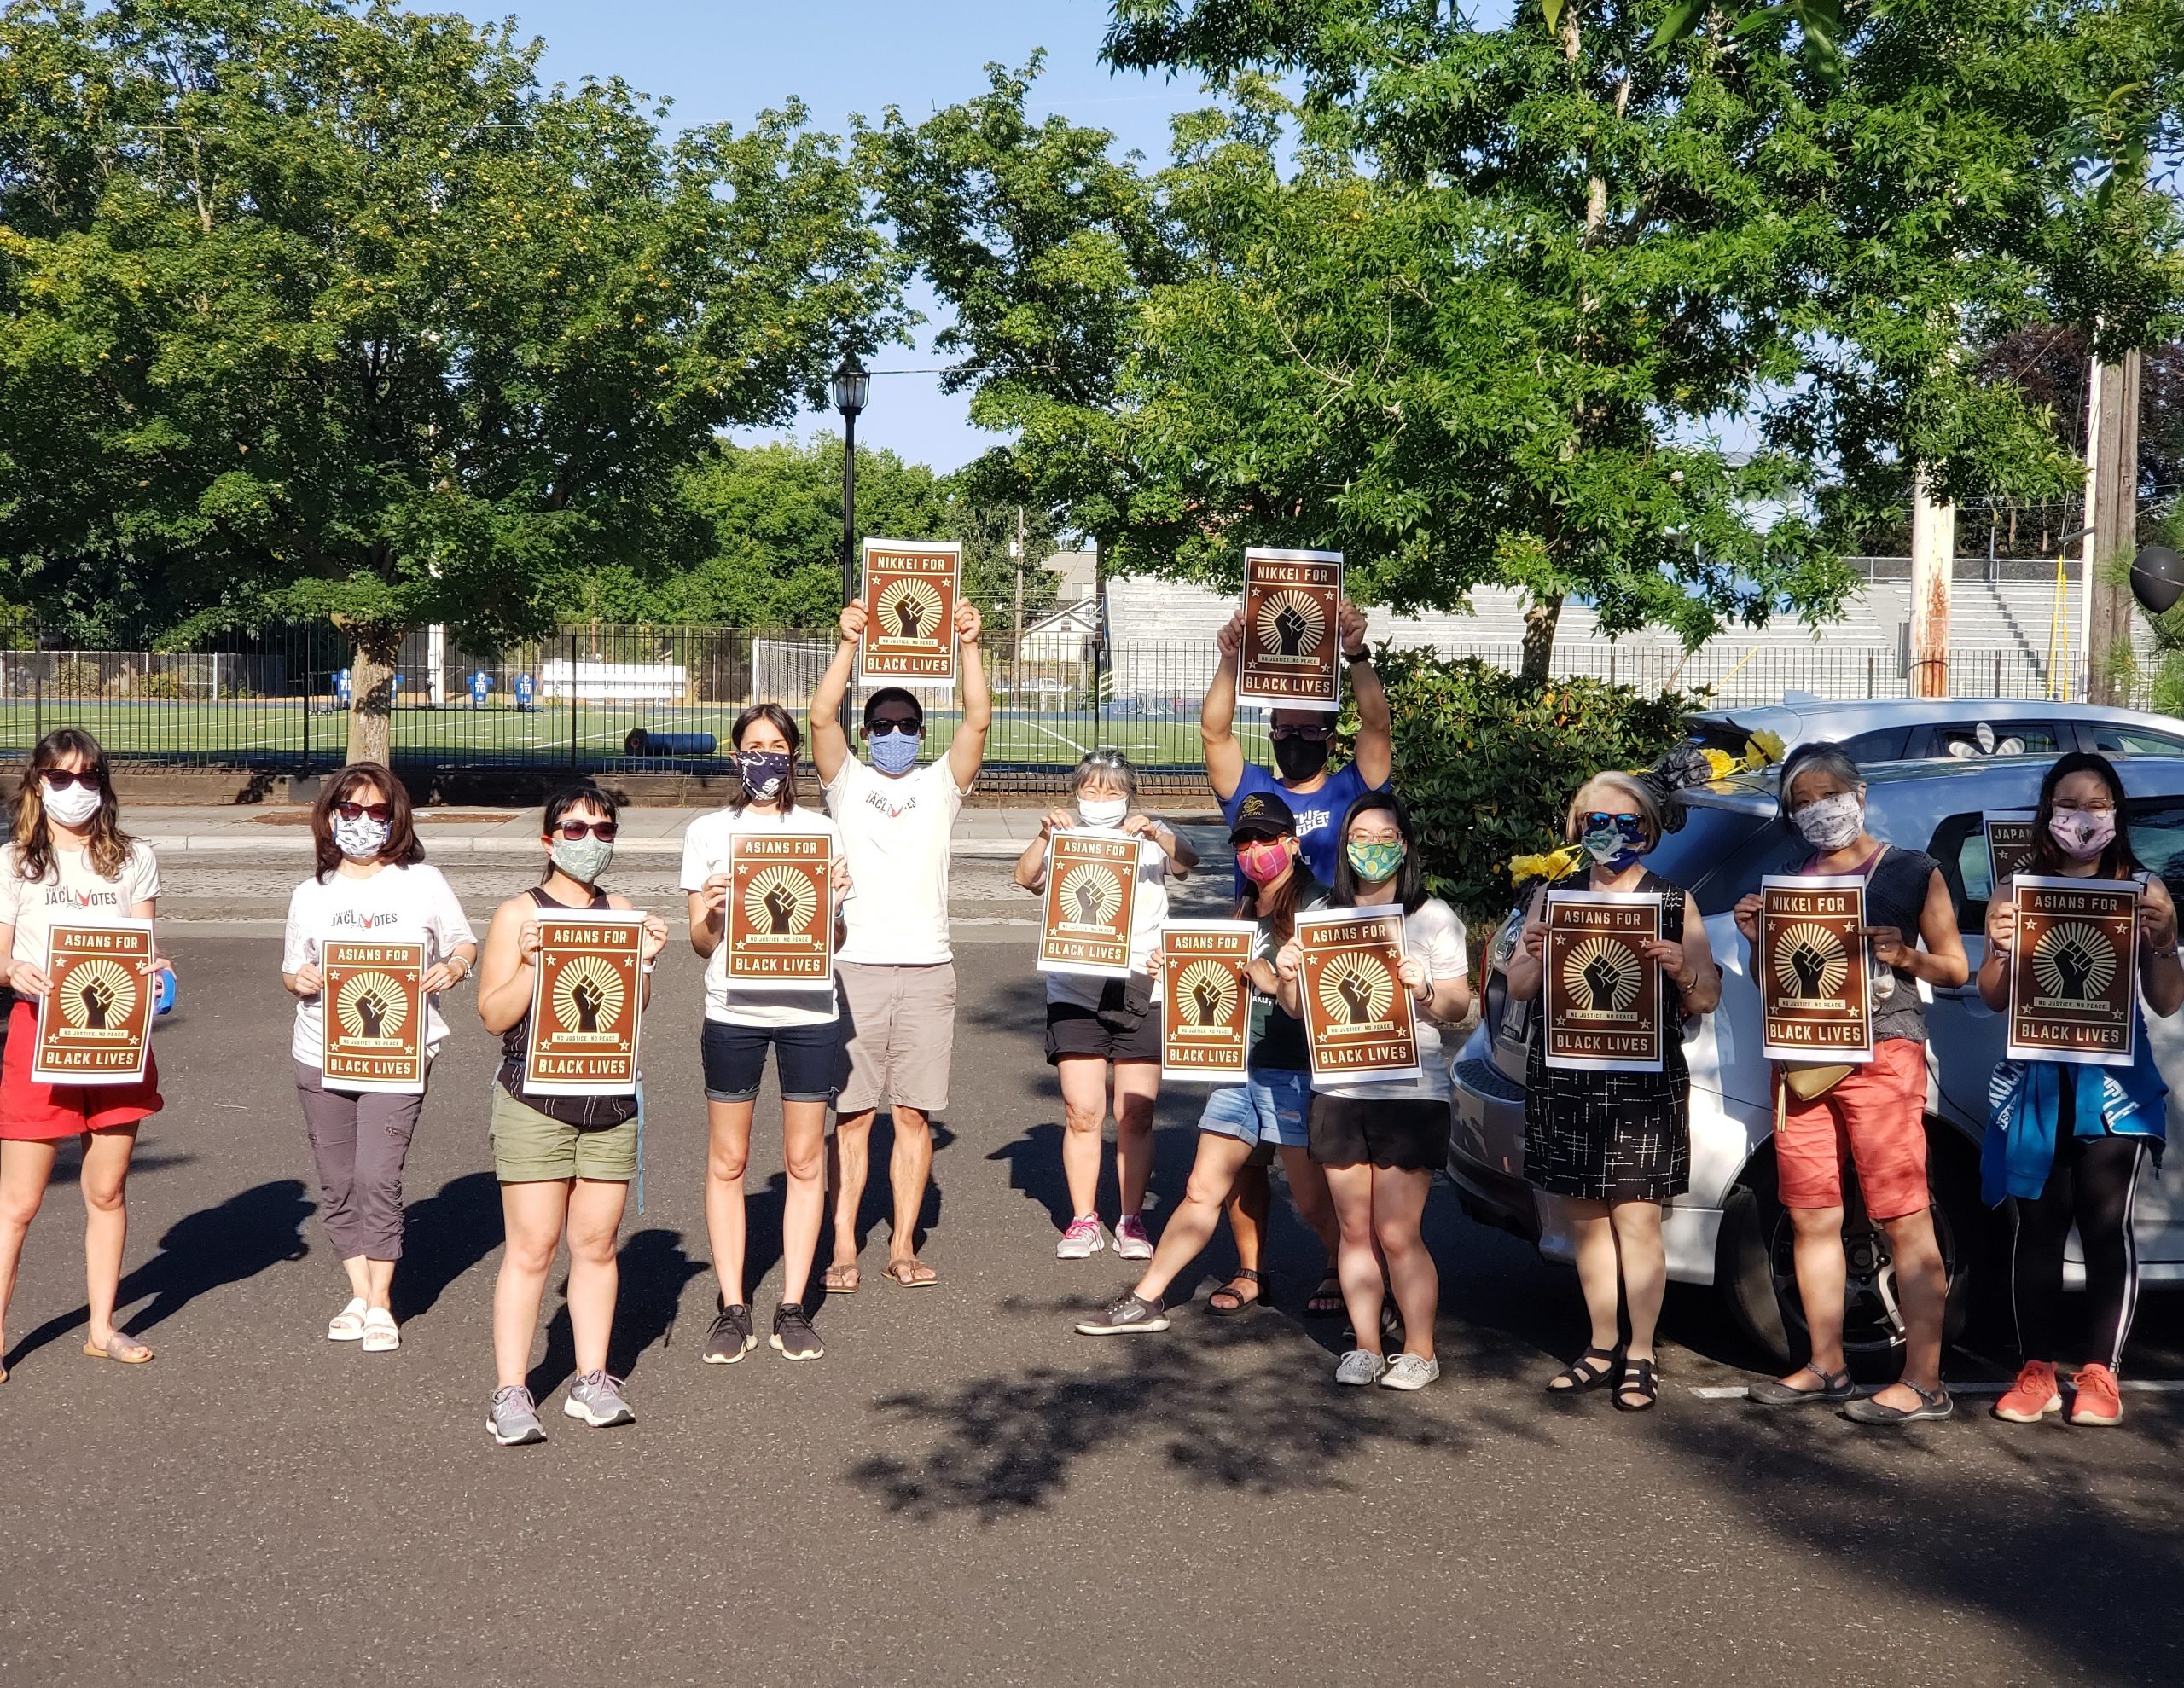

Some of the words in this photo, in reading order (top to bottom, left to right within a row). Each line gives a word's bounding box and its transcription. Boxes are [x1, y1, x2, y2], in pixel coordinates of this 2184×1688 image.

[877, 556, 917, 569] NIKKEI
[922, 558, 945, 570] FOR
[1258, 566, 1299, 581] NIKKEI
[1304, 569, 1327, 582] FOR
[868, 658, 908, 670] BLACK
[912, 659, 948, 671] LIVES
[1246, 676, 1287, 691] BLACK
[1292, 679, 1330, 693] LIVES
[745, 841, 790, 854] ASIANS
[794, 842, 817, 854] FOR
[1064, 842, 1101, 855] ASIANS
[1106, 845, 1126, 857] FOR
[1772, 896, 1811, 912] NIKKEI
[1817, 897, 1845, 912] FOR
[2034, 896, 2086, 909] ASIANS
[2091, 898, 2117, 911] FOR
[1564, 911, 1611, 925] ASIANS
[1617, 913, 1641, 925] FOR
[64, 934, 111, 948] ASIANS
[115, 936, 138, 948] FOR
[554, 929, 599, 943] ASIANS
[603, 931, 627, 943] FOR
[1312, 927, 1357, 943] ASIANS
[1362, 925, 1385, 938] FOR
[1175, 937, 1213, 948] ASIANS
[1217, 937, 1238, 948] FOR
[338, 948, 381, 960] ASIANS
[386, 949, 409, 961] FOR
[1048, 943, 1084, 957] BLACK
[1089, 946, 1122, 960] LIVES
[735, 958, 777, 971] BLACK
[783, 959, 821, 971] LIVES
[1769, 1024, 1812, 1040] BLACK
[1818, 1025, 1861, 1041] LIVES
[2021, 1024, 2070, 1040] BLACK
[2076, 1027, 2120, 1043] LIVES
[1556, 1035, 1600, 1050] BLACK
[1607, 1037, 1648, 1051] LIVES
[46, 1052, 90, 1064] BLACK
[96, 1053, 134, 1064] LIVES
[1170, 1049, 1204, 1062] BLACK
[1209, 1050, 1239, 1063] LIVES
[1321, 1048, 1363, 1064] BLACK
[1368, 1046, 1407, 1061] LIVES
[330, 1059, 369, 1073] BLACK
[375, 1061, 411, 1075] LIVES
[538, 1059, 583, 1074] BLACK
[589, 1059, 625, 1074] LIVES
